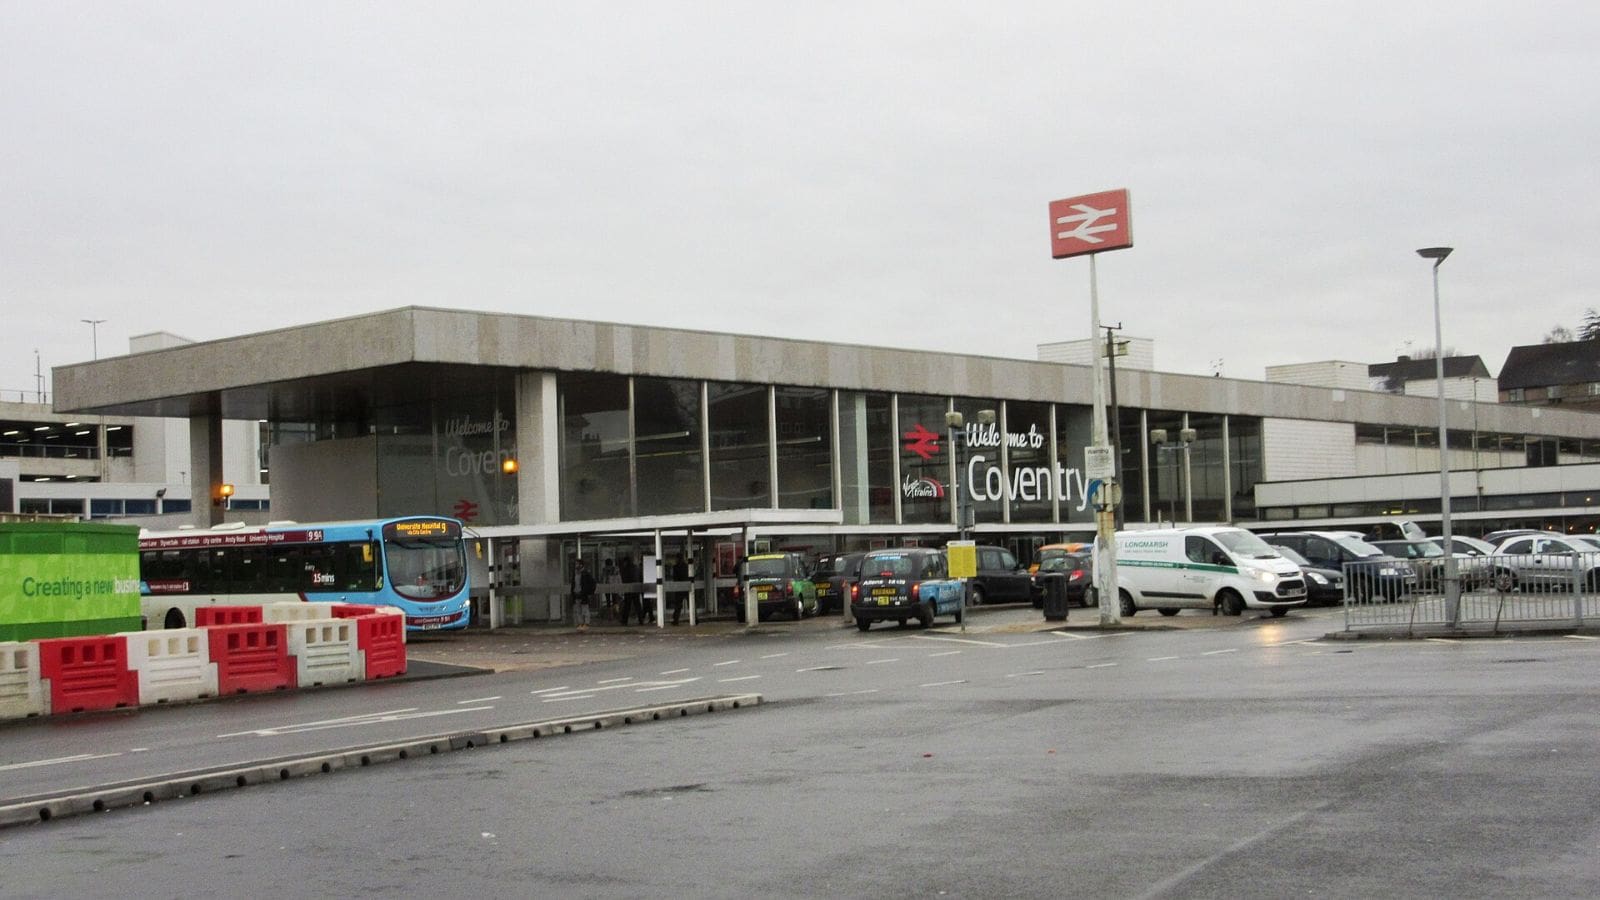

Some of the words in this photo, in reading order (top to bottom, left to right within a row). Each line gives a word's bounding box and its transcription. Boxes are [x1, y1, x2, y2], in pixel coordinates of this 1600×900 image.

[1028, 423, 1044, 449] to
[968, 455, 1090, 511] Coventry
[268, 532, 285, 541] Hospital
[1125, 541, 1168, 549] LONGMARSH
[23, 577, 82, 600] Creating
[85, 581, 91, 594] a
[94, 580, 113, 594] new
